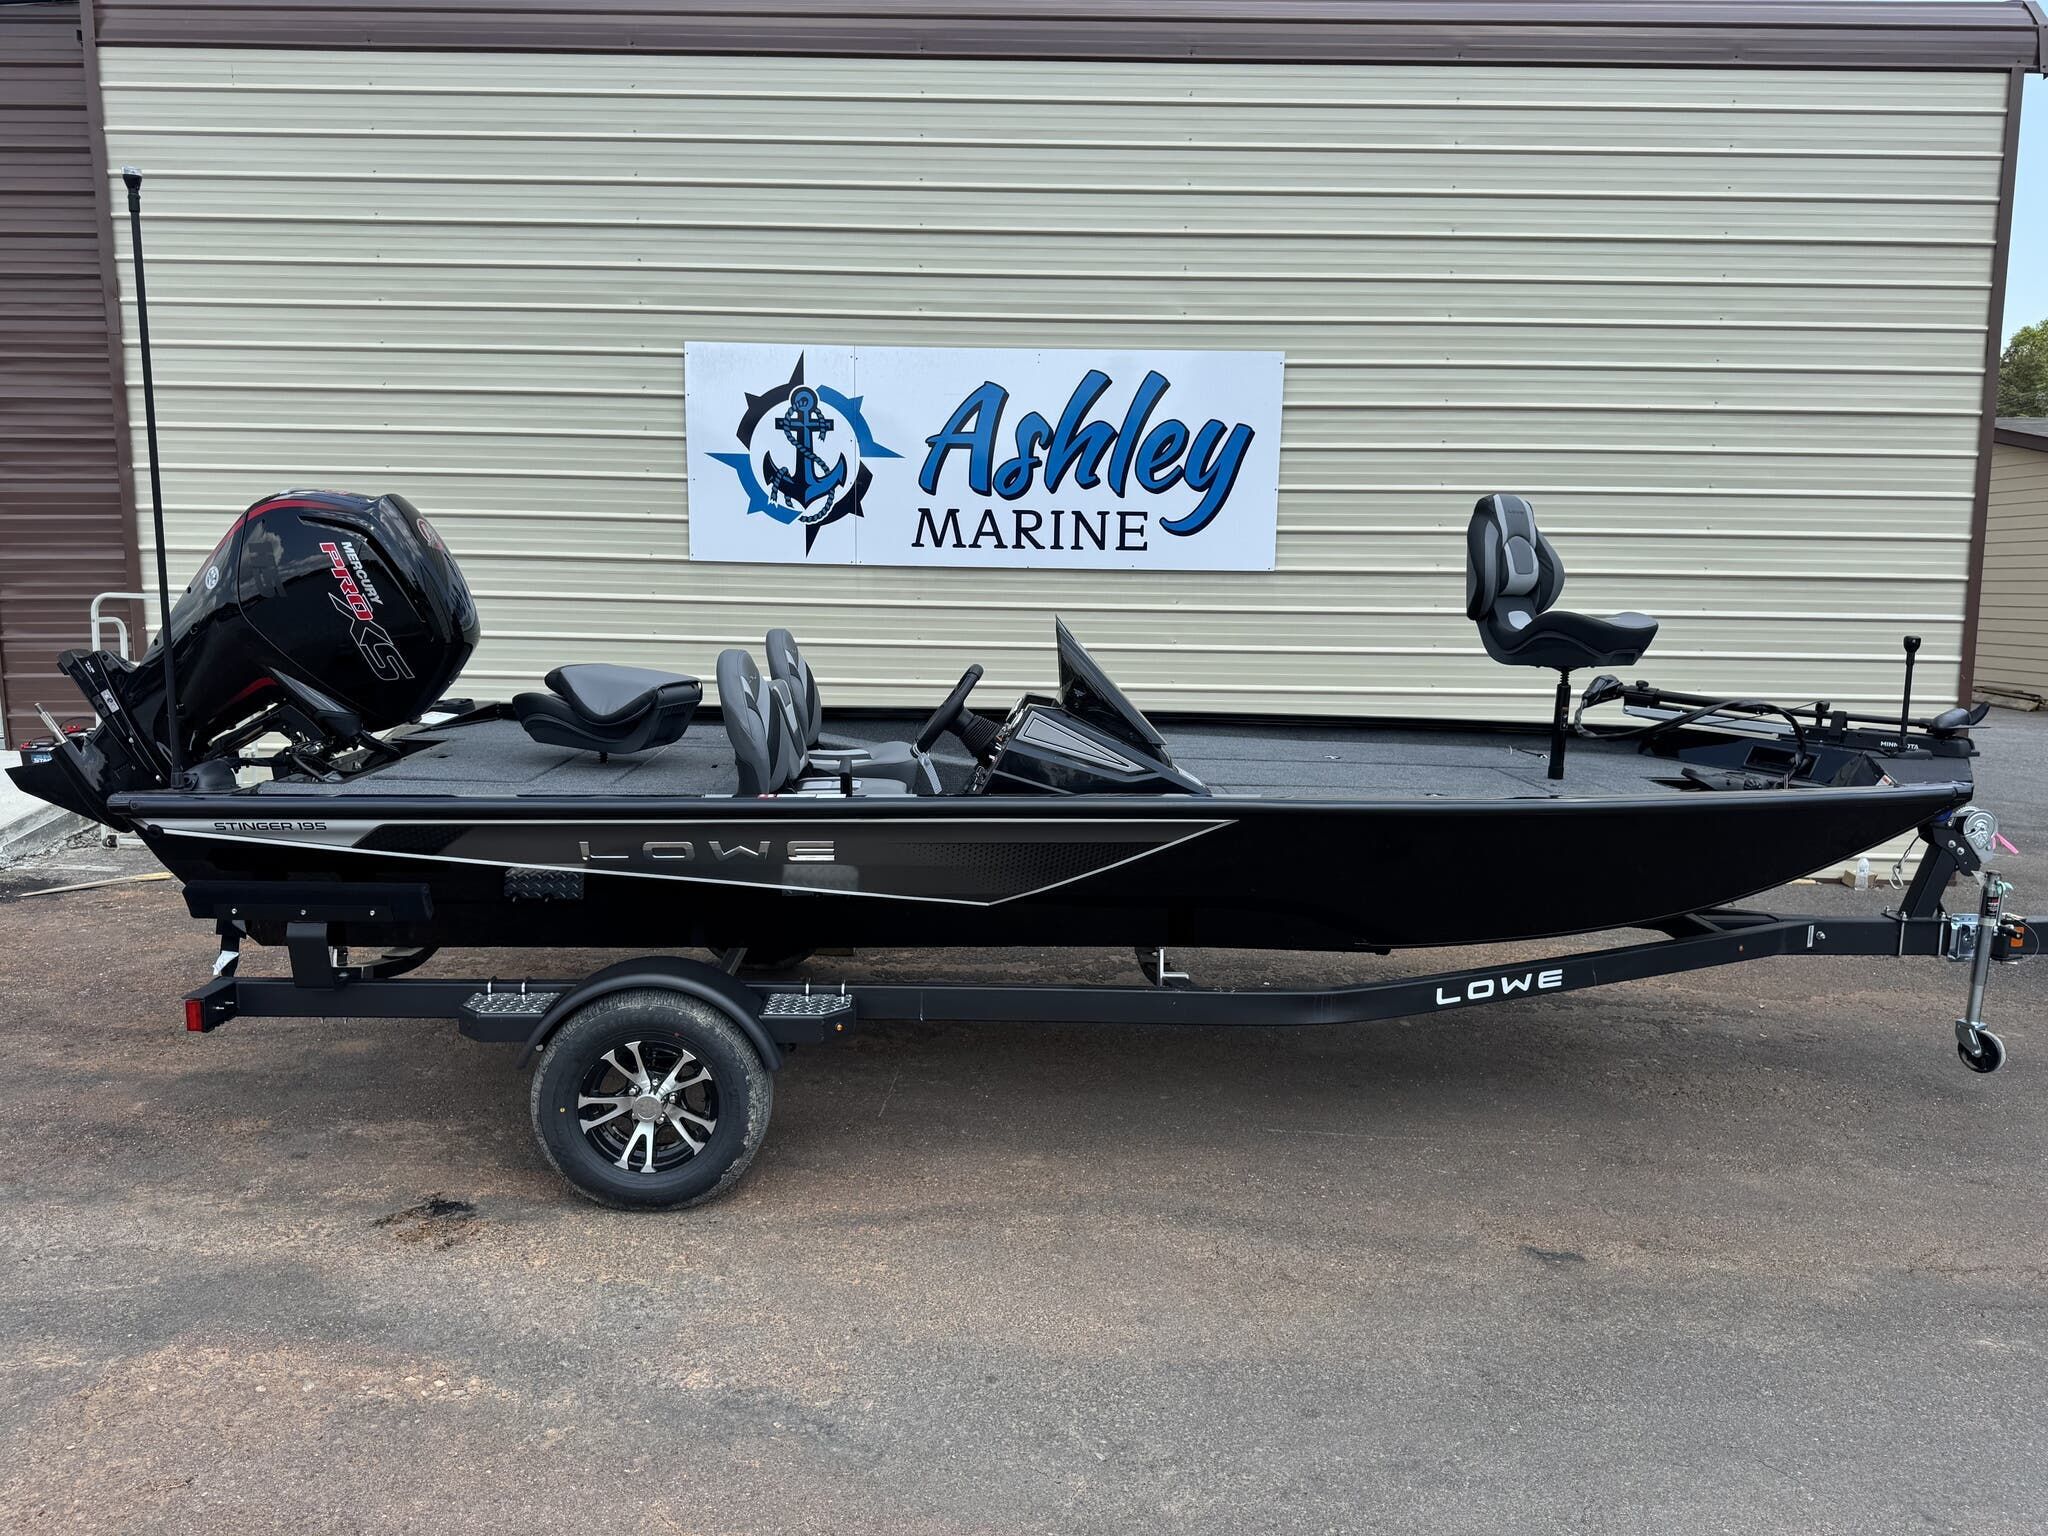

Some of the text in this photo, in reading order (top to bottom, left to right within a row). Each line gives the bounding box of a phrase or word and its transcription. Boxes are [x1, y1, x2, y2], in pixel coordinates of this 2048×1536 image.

[918, 369, 1255, 537] Ashley
[911, 507, 1148, 551] MARINE
[319, 542, 374, 621] PRO
[341, 541, 384, 605] MERCURY
[213, 821, 327, 831] STINGER 195
[579, 840, 835, 862] LOWE
[1436, 968, 1563, 1006] LOWE
